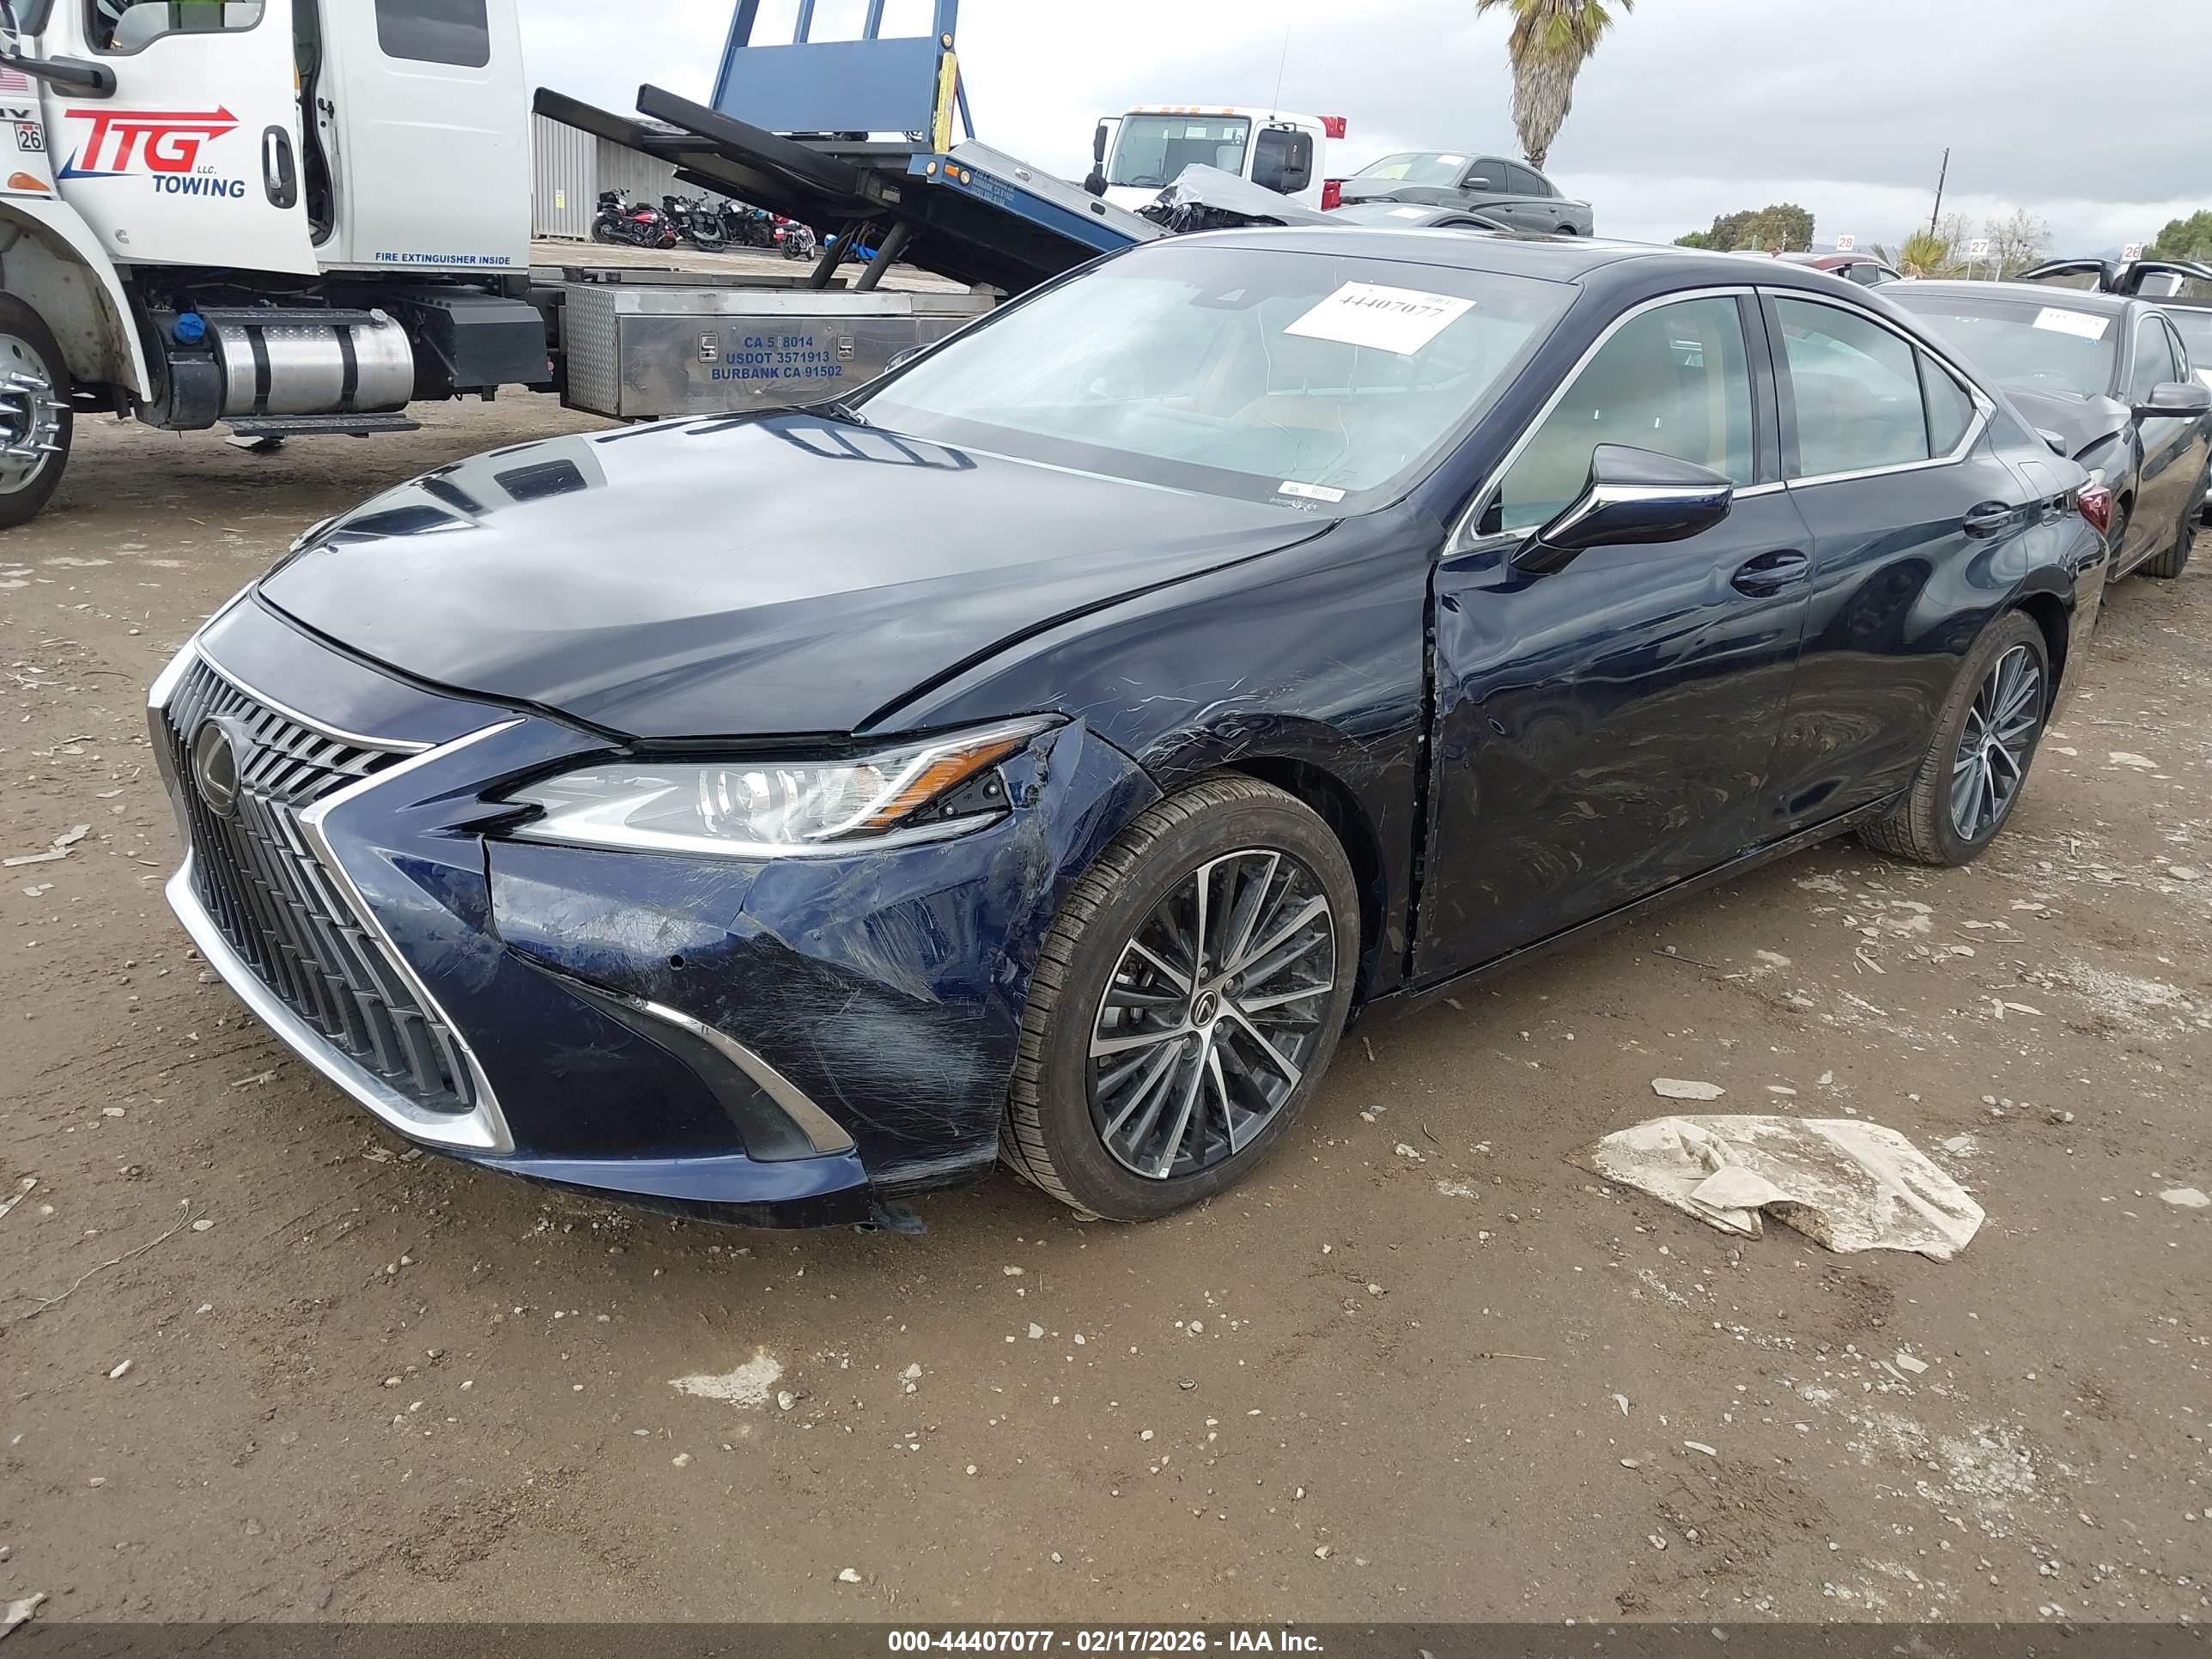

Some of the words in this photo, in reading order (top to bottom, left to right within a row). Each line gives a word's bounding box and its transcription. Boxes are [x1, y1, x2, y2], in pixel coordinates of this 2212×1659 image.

[19, 131, 41, 149] 26
[64, 105, 240, 173] TTG
[152, 174, 246, 198] TOWING
[1838, 237, 1853, 248] 28
[1971, 241, 1987, 252] 27
[374, 252, 399, 261] FIRE
[401, 253, 477, 264] EXTINGUISHER
[478, 256, 511, 265] INSIDE
[1340, 295, 1445, 318] 44407077
[744, 337, 763, 348] CA
[726, 352, 773, 364] USDOT
[776, 350, 830, 364] 3571913
[711, 367, 780, 380] BURBANK
[783, 367, 801, 378] CA
[805, 365, 842, 377] 91502
